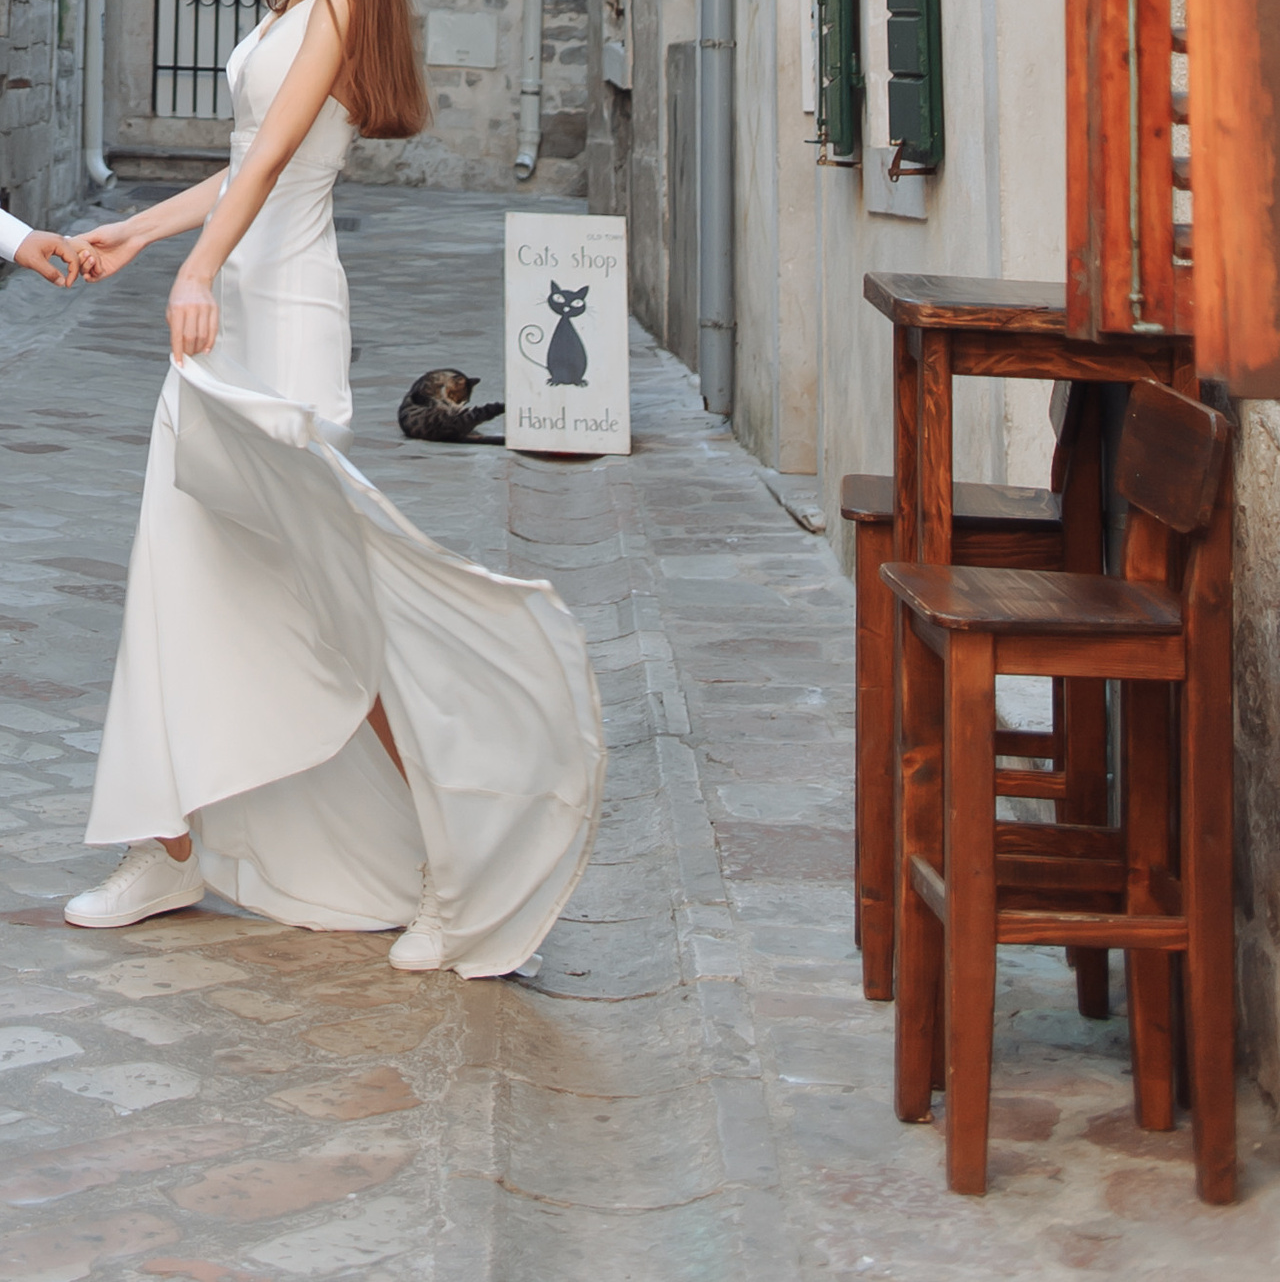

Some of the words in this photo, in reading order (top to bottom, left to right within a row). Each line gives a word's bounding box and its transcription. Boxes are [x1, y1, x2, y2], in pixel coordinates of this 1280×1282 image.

[518, 244, 559, 268] Cats
[571, 245, 618, 278] shop
[518, 406, 566, 430] Hand
[574, 408, 619, 433] made
